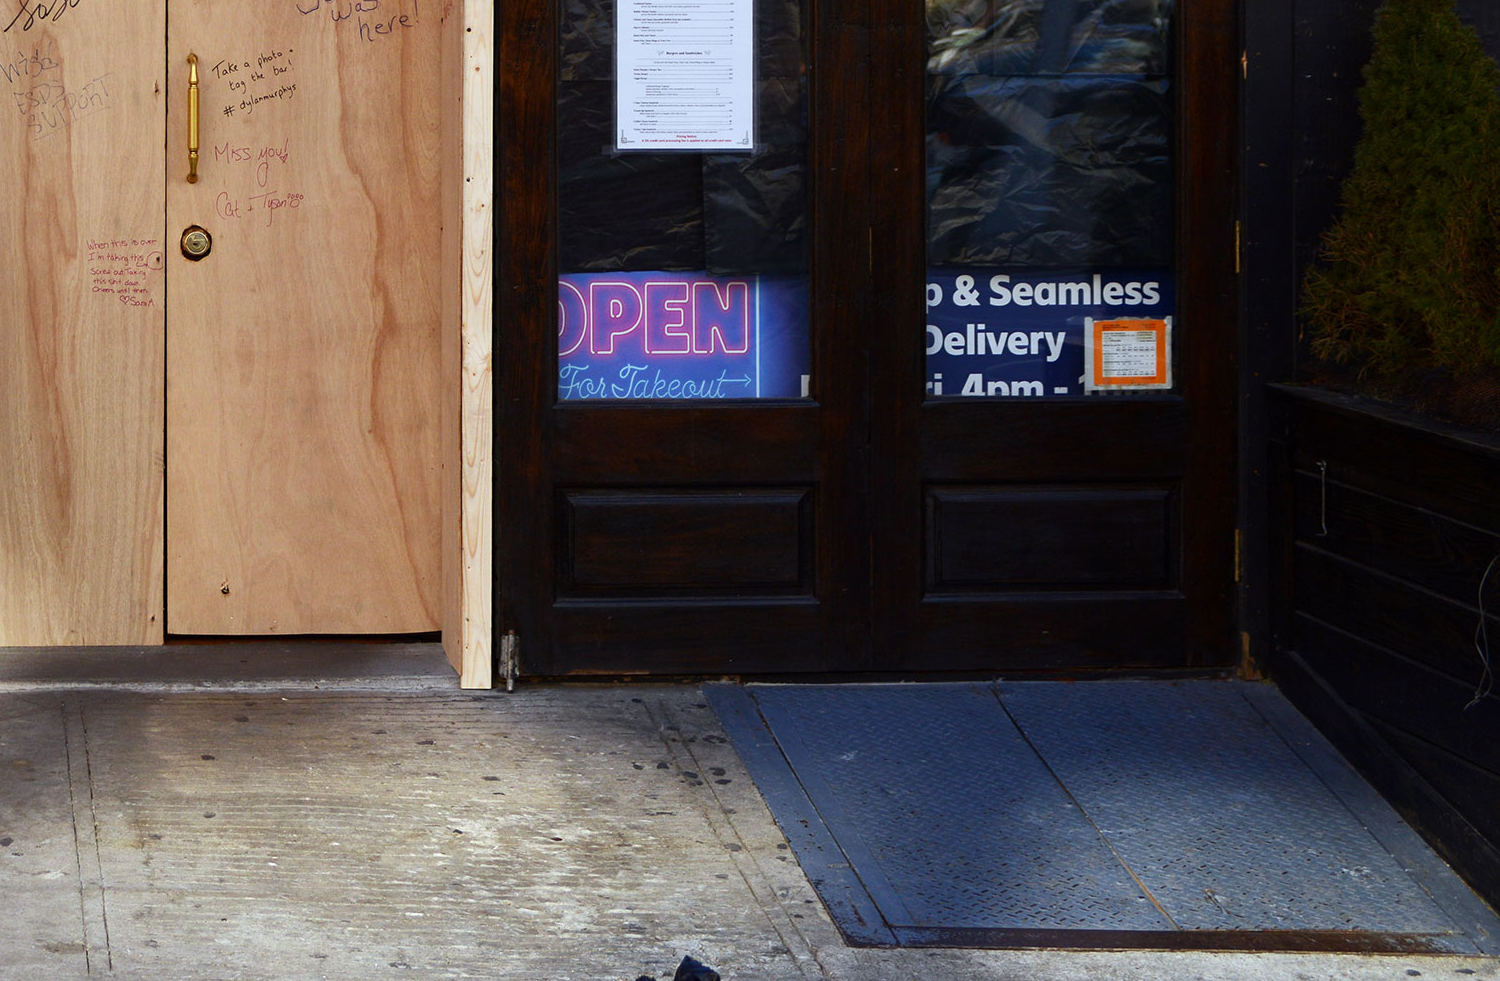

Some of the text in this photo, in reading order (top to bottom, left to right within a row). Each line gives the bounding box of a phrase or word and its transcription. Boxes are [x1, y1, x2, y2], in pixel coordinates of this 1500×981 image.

[212, 60, 239, 79] Take
[257, 50, 282, 68] photo
[229, 81, 246, 94] tag
[251, 72, 265, 81] the
[215, 142, 250, 163] Miss
[216, 192, 241, 219] Cat
[952, 274, 980, 306] &
[989, 274, 1161, 307] Seamless
[926, 323, 1066, 362] Delivery
[558, 363, 730, 399] For Takeout
